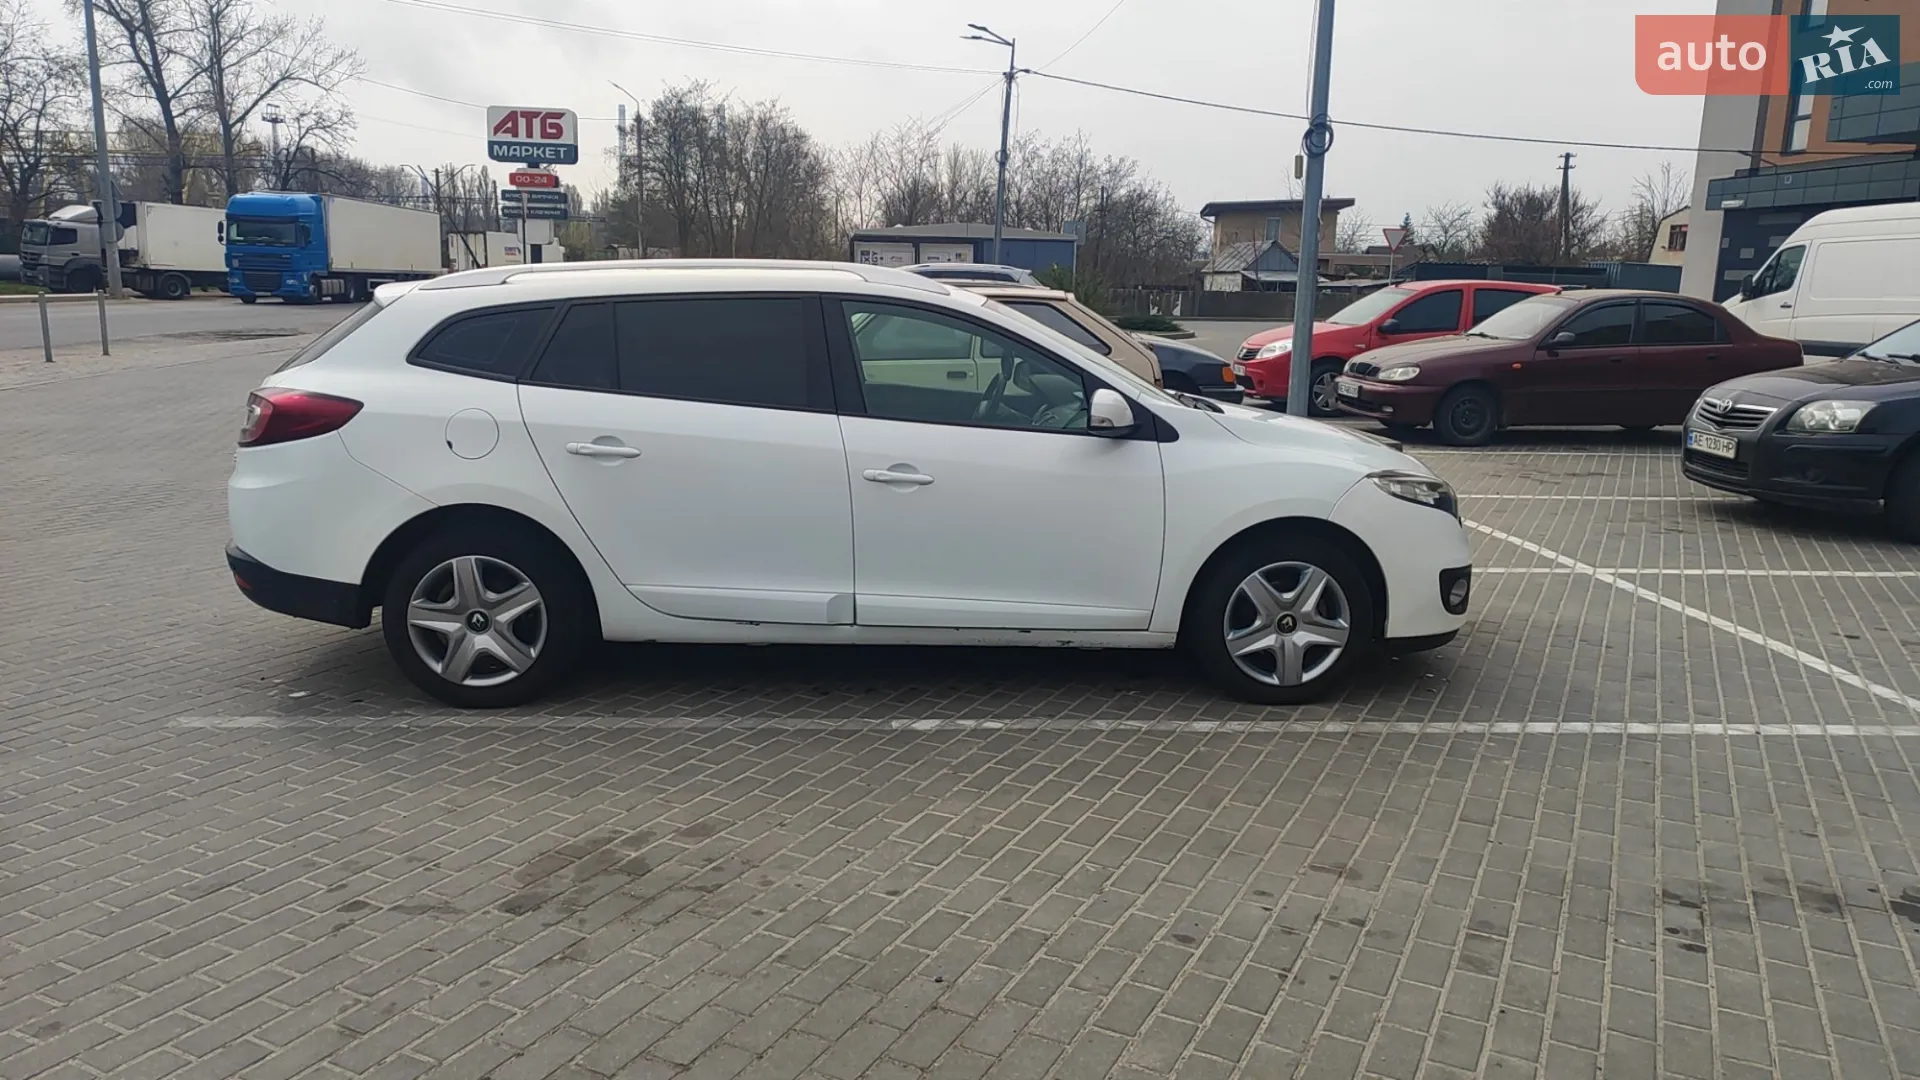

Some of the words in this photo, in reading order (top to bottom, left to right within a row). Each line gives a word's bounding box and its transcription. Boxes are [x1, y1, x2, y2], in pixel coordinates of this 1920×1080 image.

[493, 110, 566, 139] АТБ
[493, 145, 567, 159] МАРКЕТ
[515, 175, 547, 184] 00-24
